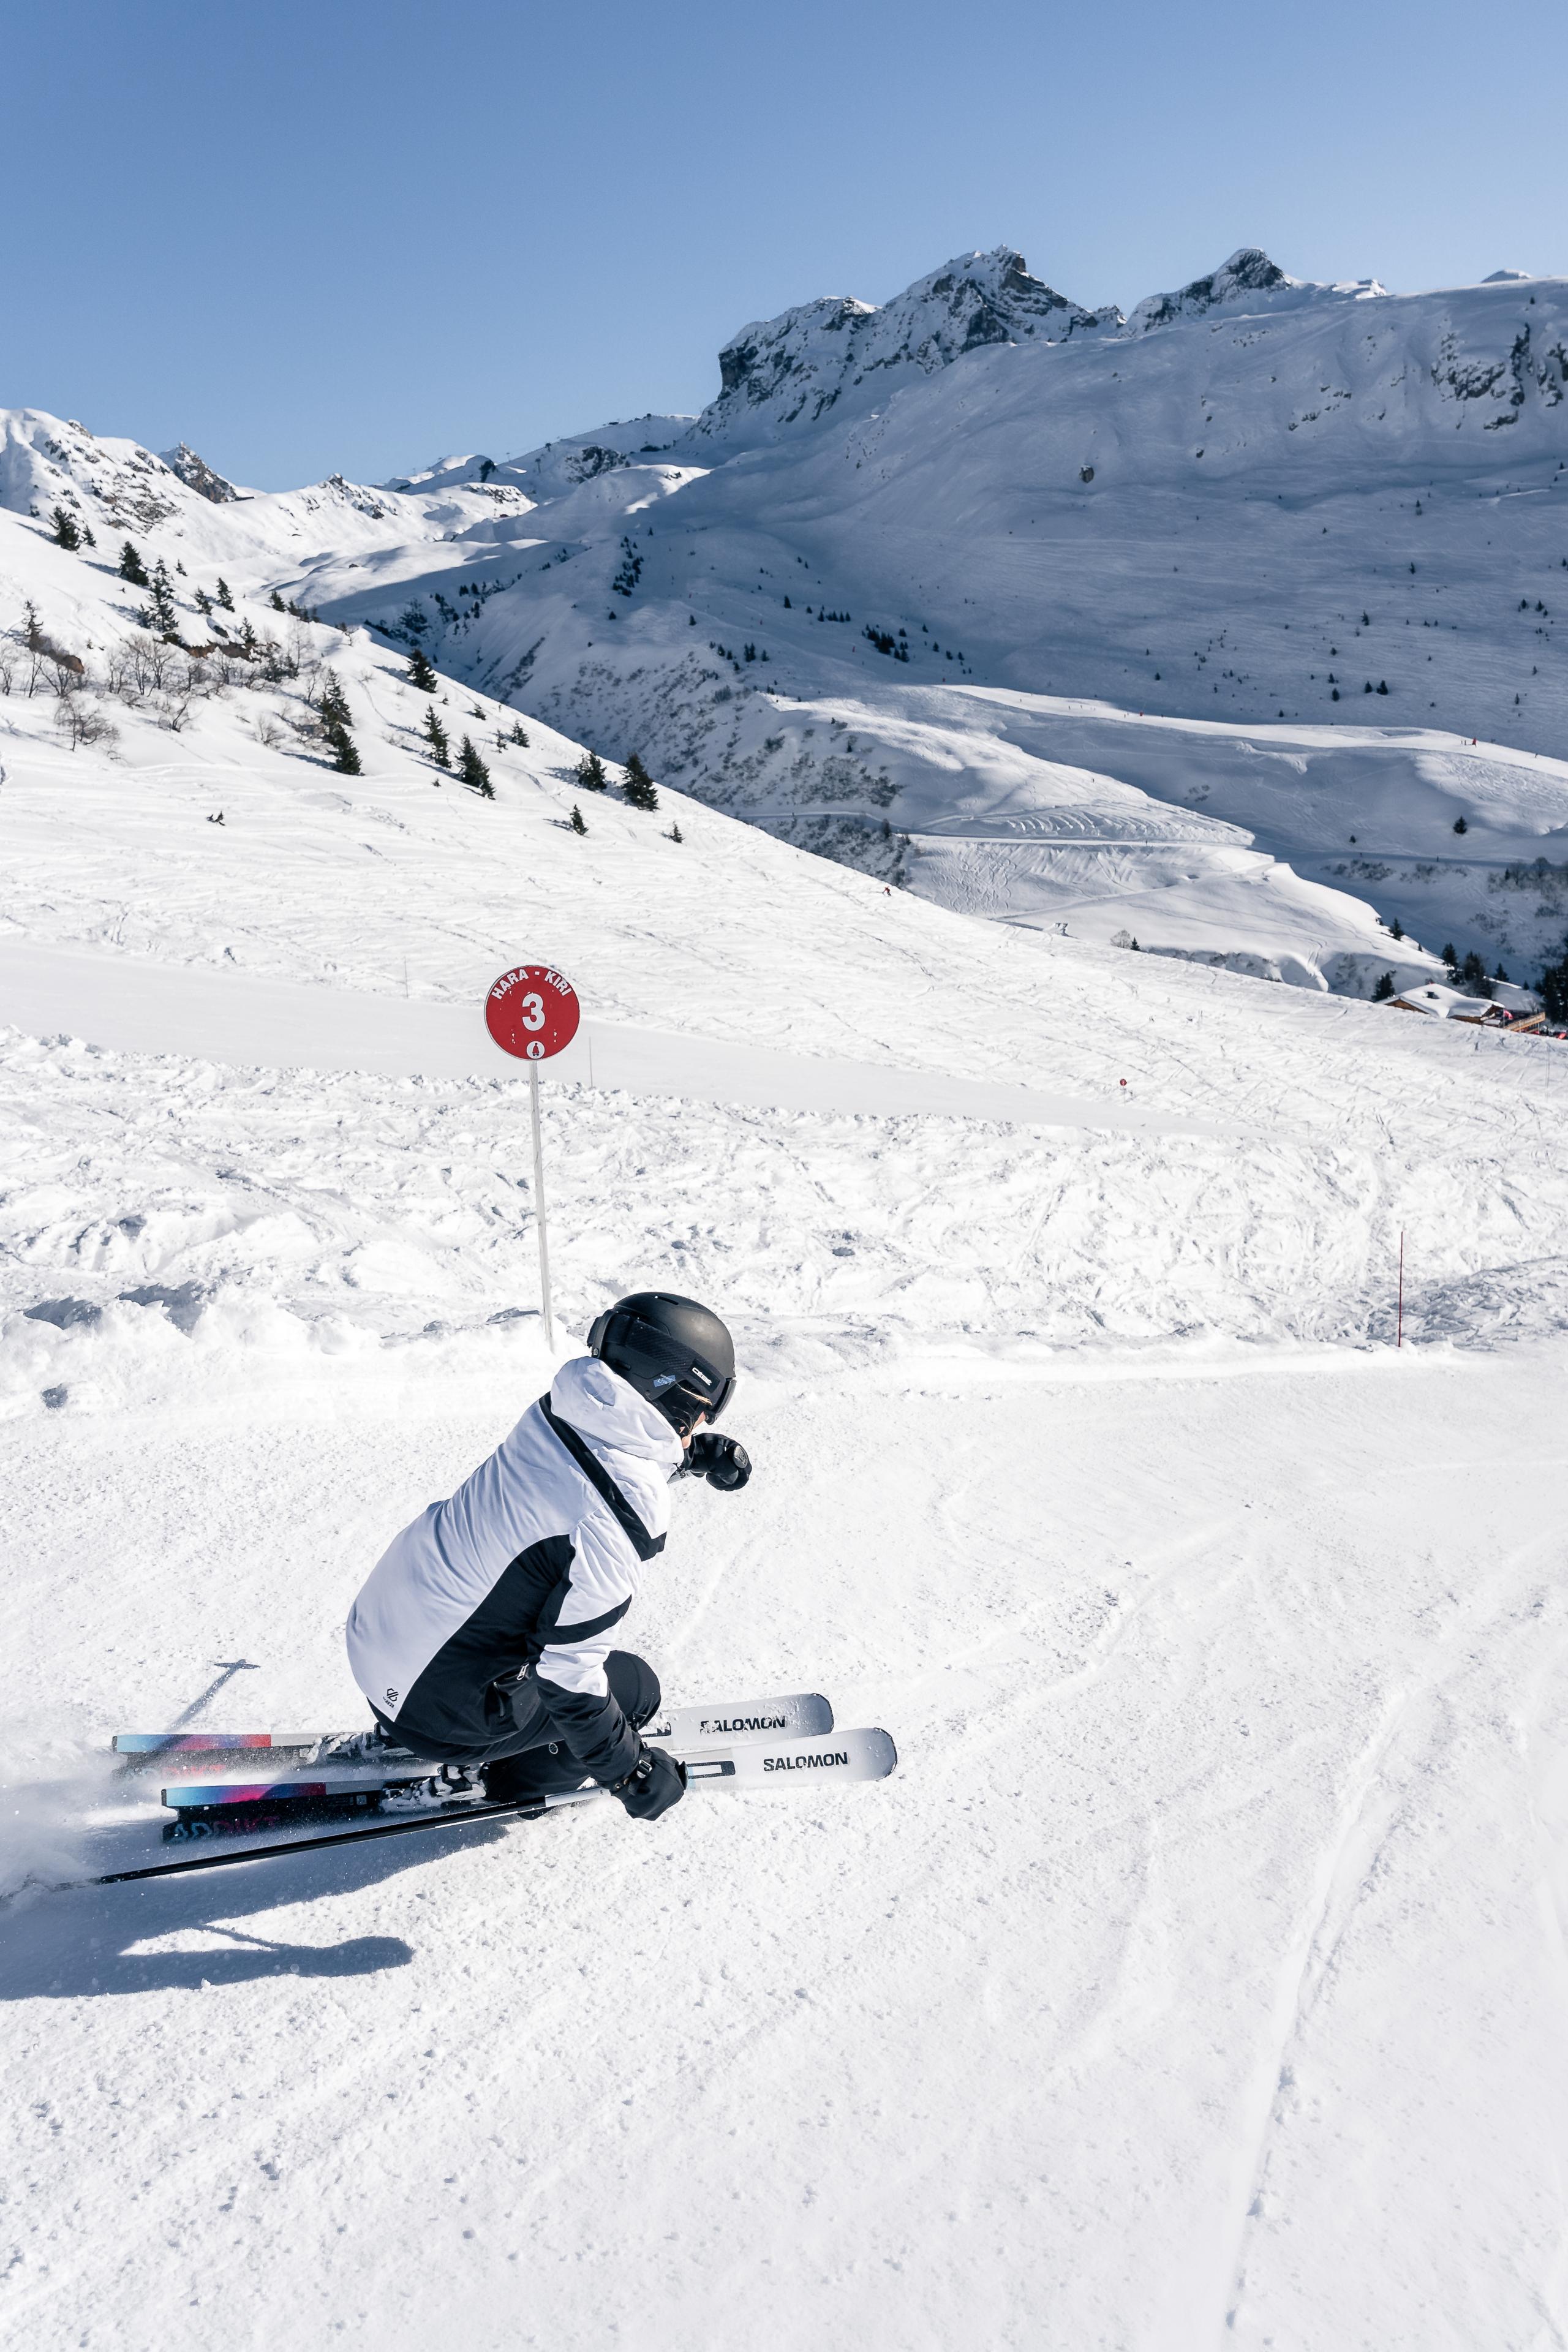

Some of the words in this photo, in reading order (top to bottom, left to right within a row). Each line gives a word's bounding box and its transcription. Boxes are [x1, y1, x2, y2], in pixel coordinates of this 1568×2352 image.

[491, 969, 529, 1000] HARA
[545, 971, 571, 996] KIRI
[522, 992, 546, 1031] 3
[763, 1752, 848, 1771] SALOMON
